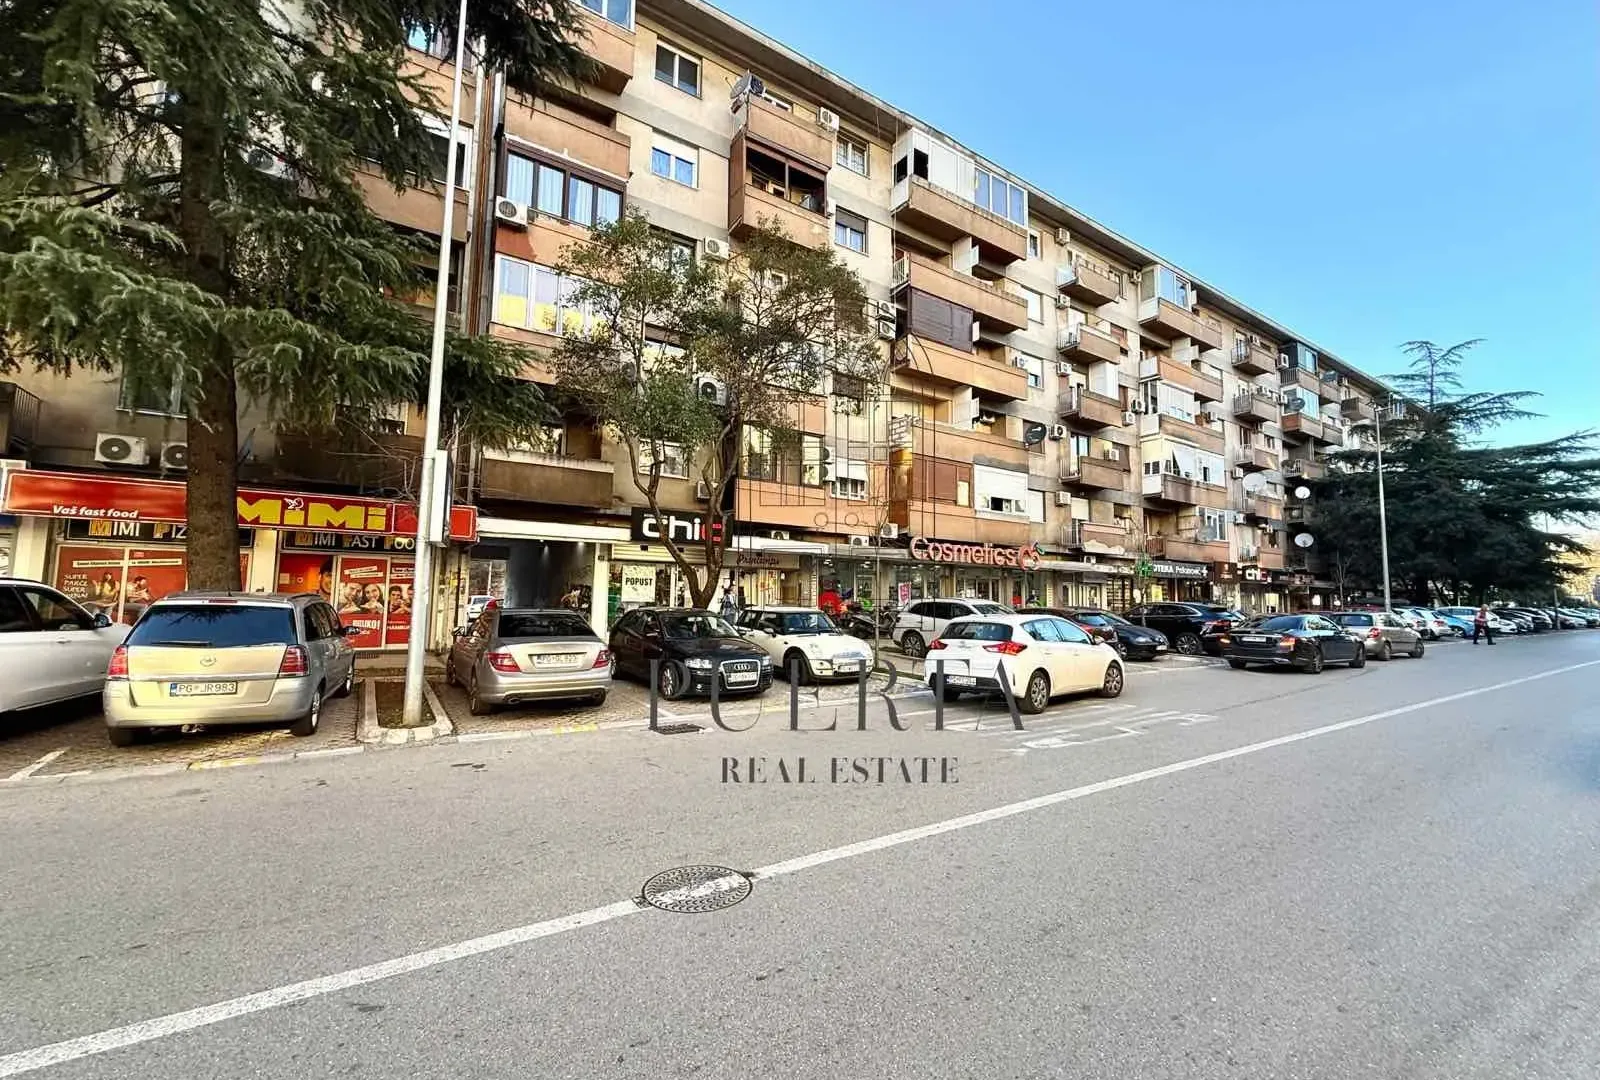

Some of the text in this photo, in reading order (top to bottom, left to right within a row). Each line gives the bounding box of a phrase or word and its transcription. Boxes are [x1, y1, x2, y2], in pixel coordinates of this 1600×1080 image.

[53, 505, 139, 519] Vaš fast food
[88, 519, 188, 539] MIMI PIZ
[295, 531, 416, 550] MIMI FAST FOO
[910, 536, 1018, 566] Cosmetics
[625, 577, 653, 587] POPUST
